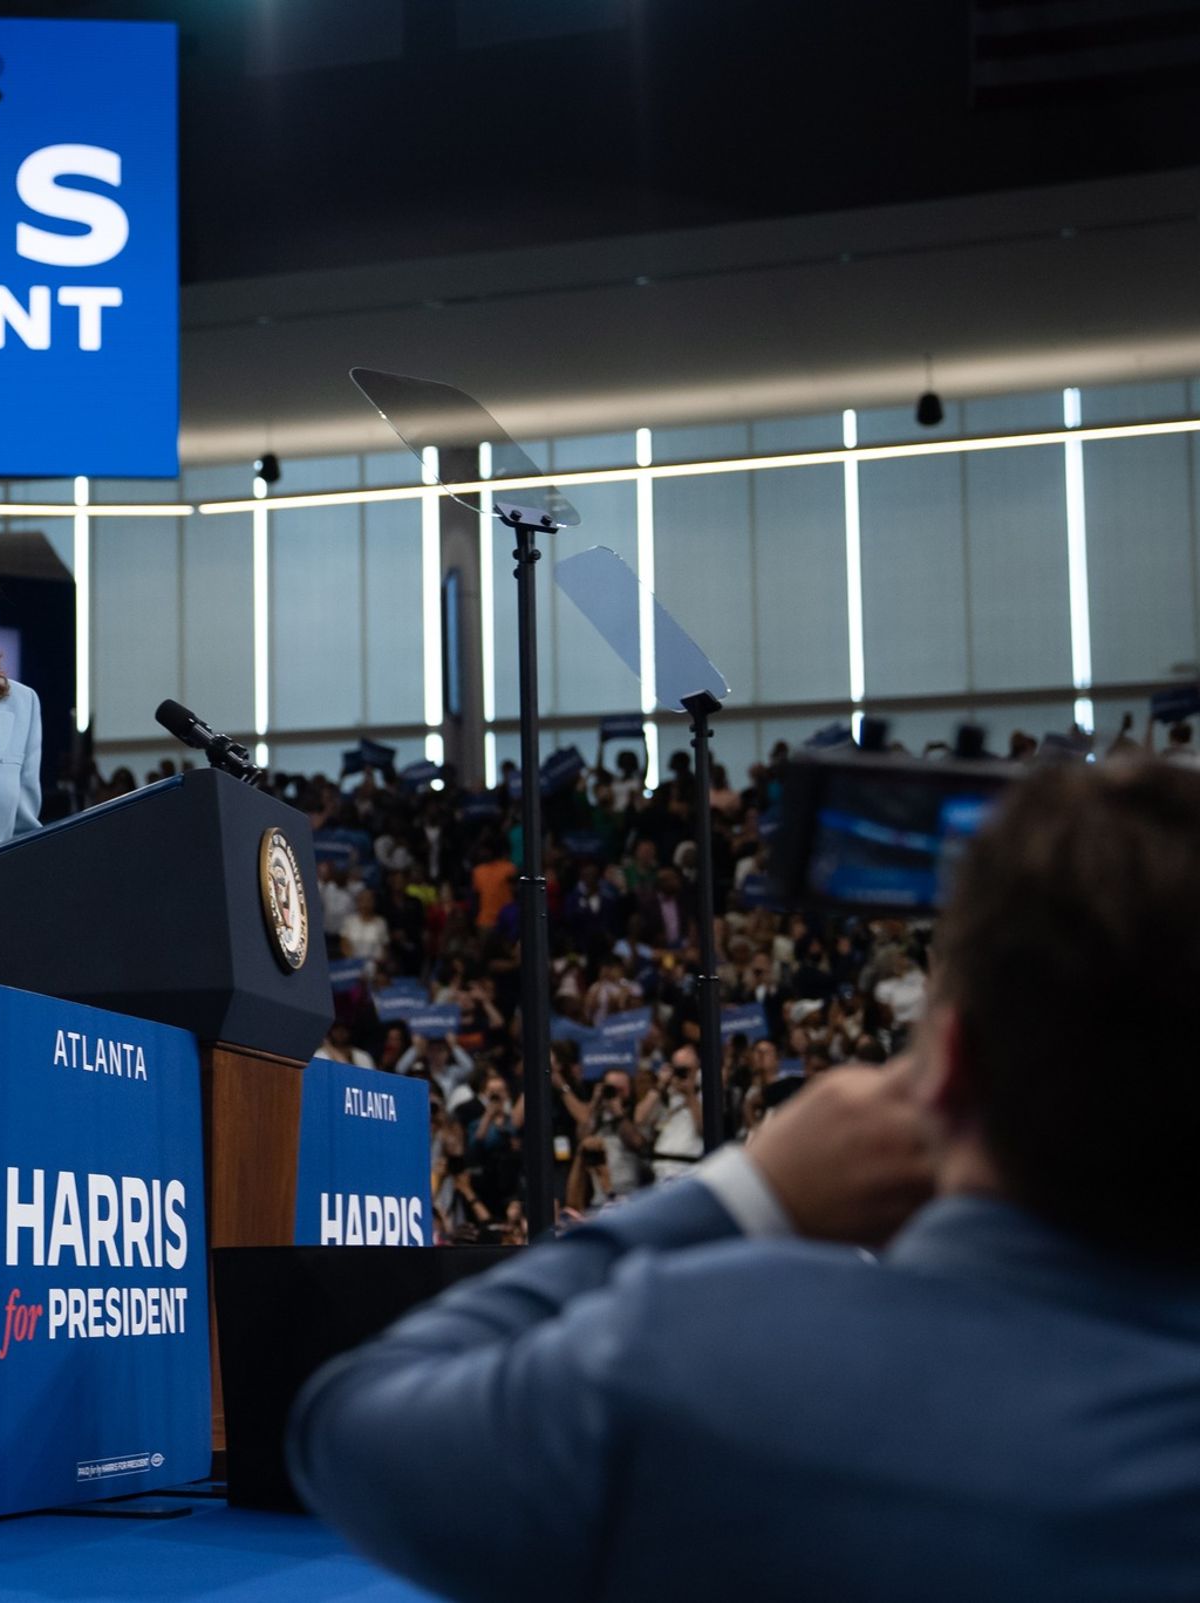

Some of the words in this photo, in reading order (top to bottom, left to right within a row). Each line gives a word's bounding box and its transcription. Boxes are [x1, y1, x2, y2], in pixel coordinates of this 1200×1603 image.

[53, 1029, 147, 1081] ATLANTA
[345, 1087, 396, 1123] ATLANTA
[6, 1166, 188, 1270] HARRIS
[320, 1192, 424, 1247] HARRIS
[47, 1287, 188, 1340] PRESIDENT
